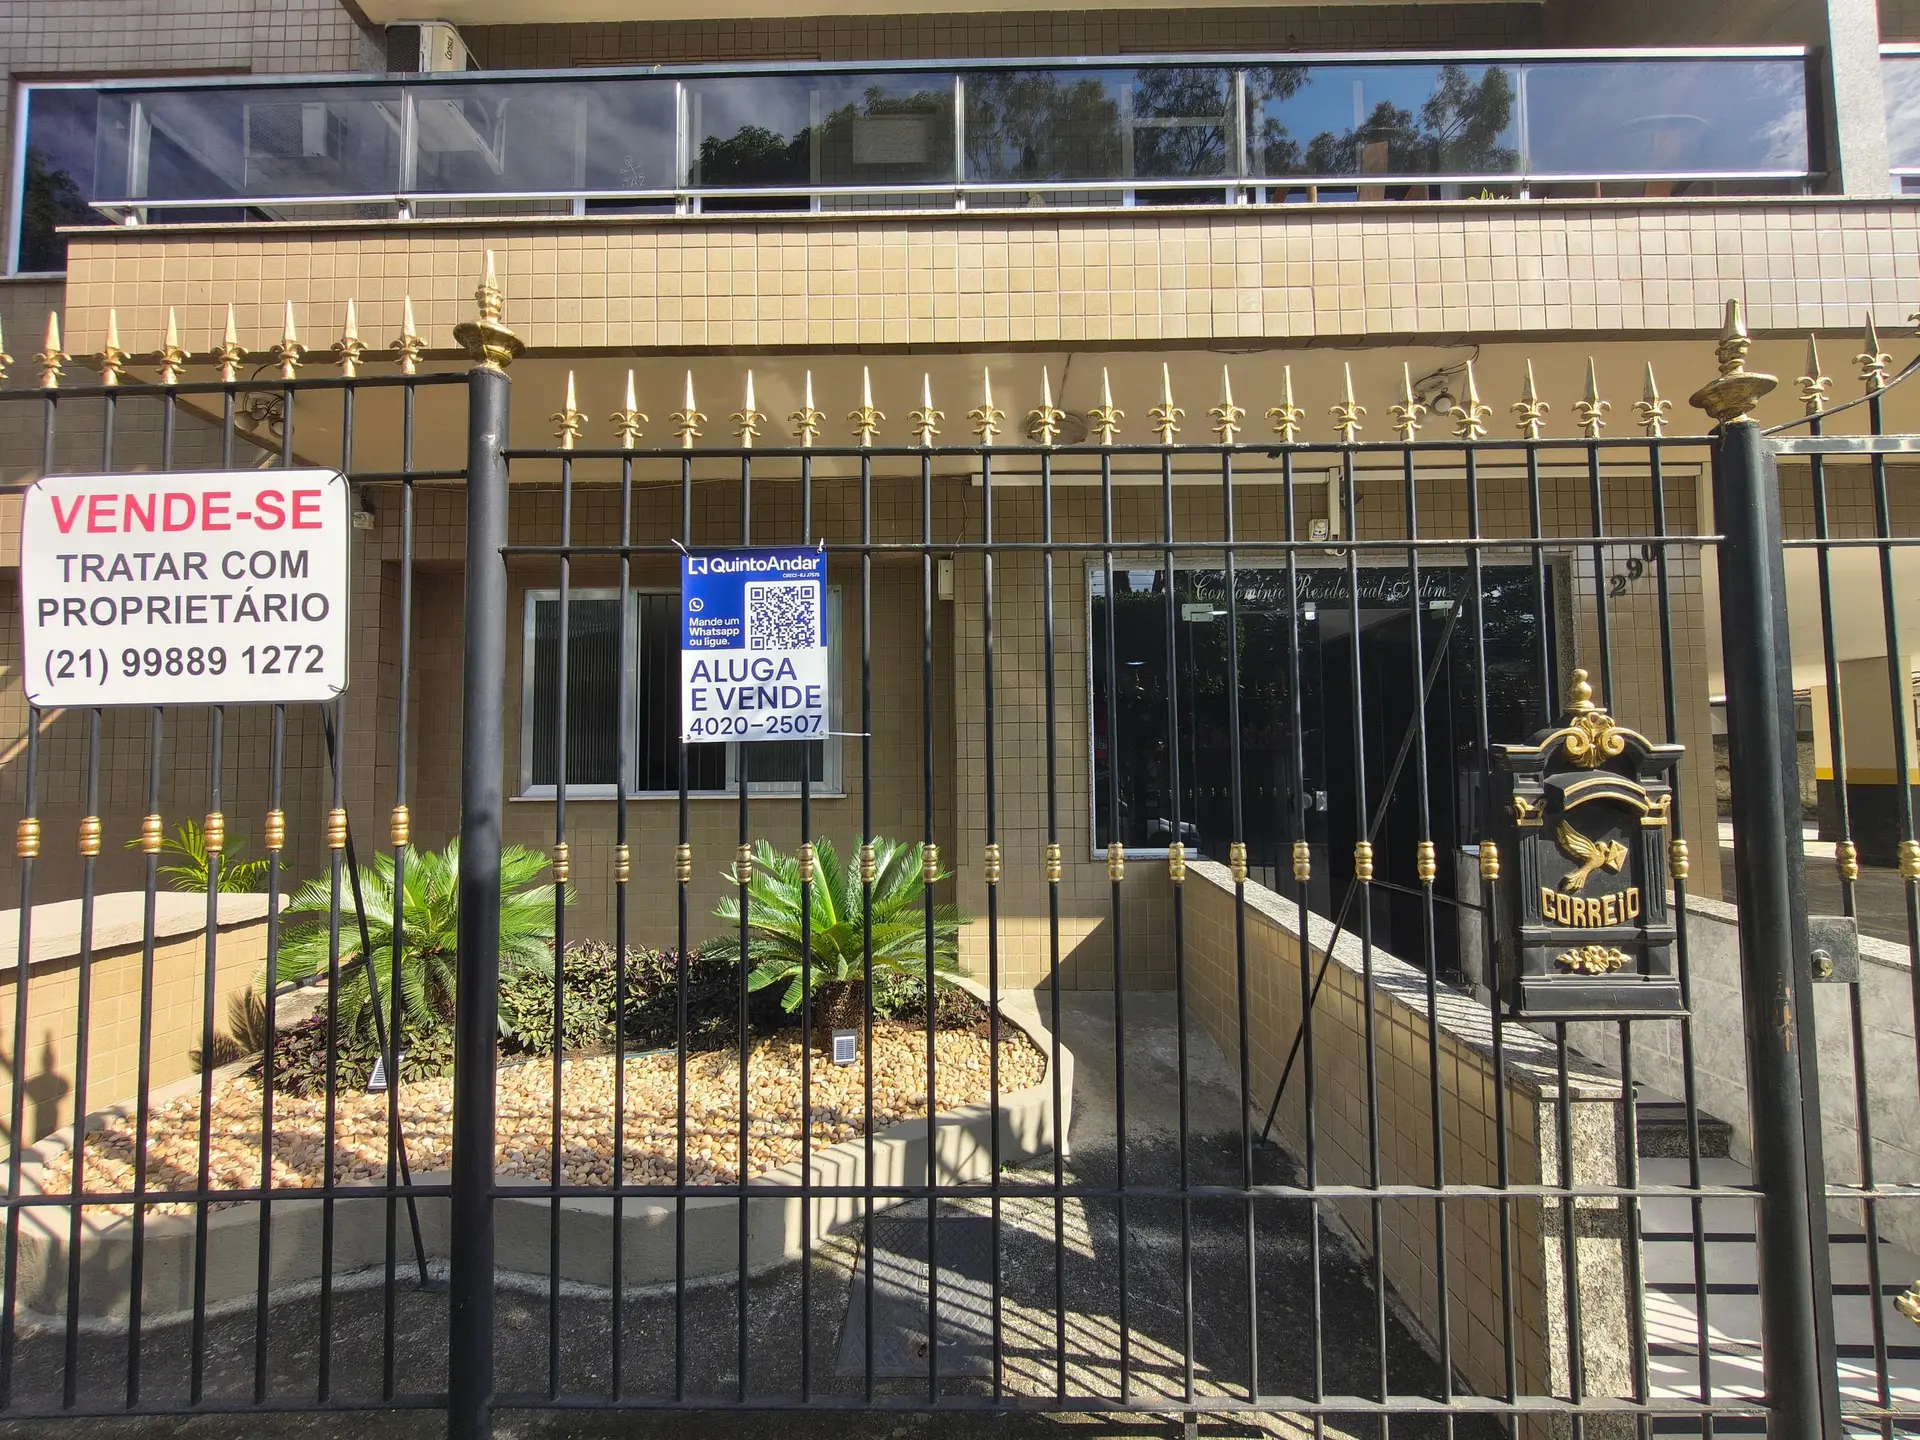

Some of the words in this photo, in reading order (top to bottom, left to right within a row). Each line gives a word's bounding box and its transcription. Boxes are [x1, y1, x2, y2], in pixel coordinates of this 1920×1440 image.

[51, 489, 323, 534] VENDE-SE
[56, 551, 209, 583] TRATAR
[221, 549, 309, 580] COM
[710, 556, 820, 574] QuintoAndar
[1193, 573, 1286, 601] Conomínio
[1294, 573, 1386, 599] Residecial
[38, 586, 330, 627] PROPRIETÁRIO
[689, 617, 722, 627] Mande
[724, 618, 740, 626] um
[689, 626, 740, 638] Whatsapp
[689, 638, 702, 646] ou
[704, 636, 730, 648] ligue.
[45, 648, 109, 687] (21)
[121, 646, 227, 678] 99889
[241, 644, 324, 675] 1272
[689, 657, 798, 683] ALUGA
[691, 688, 707, 711] E
[715, 685, 822, 710] VENDE
[689, 715, 823, 736] 4020-2507
